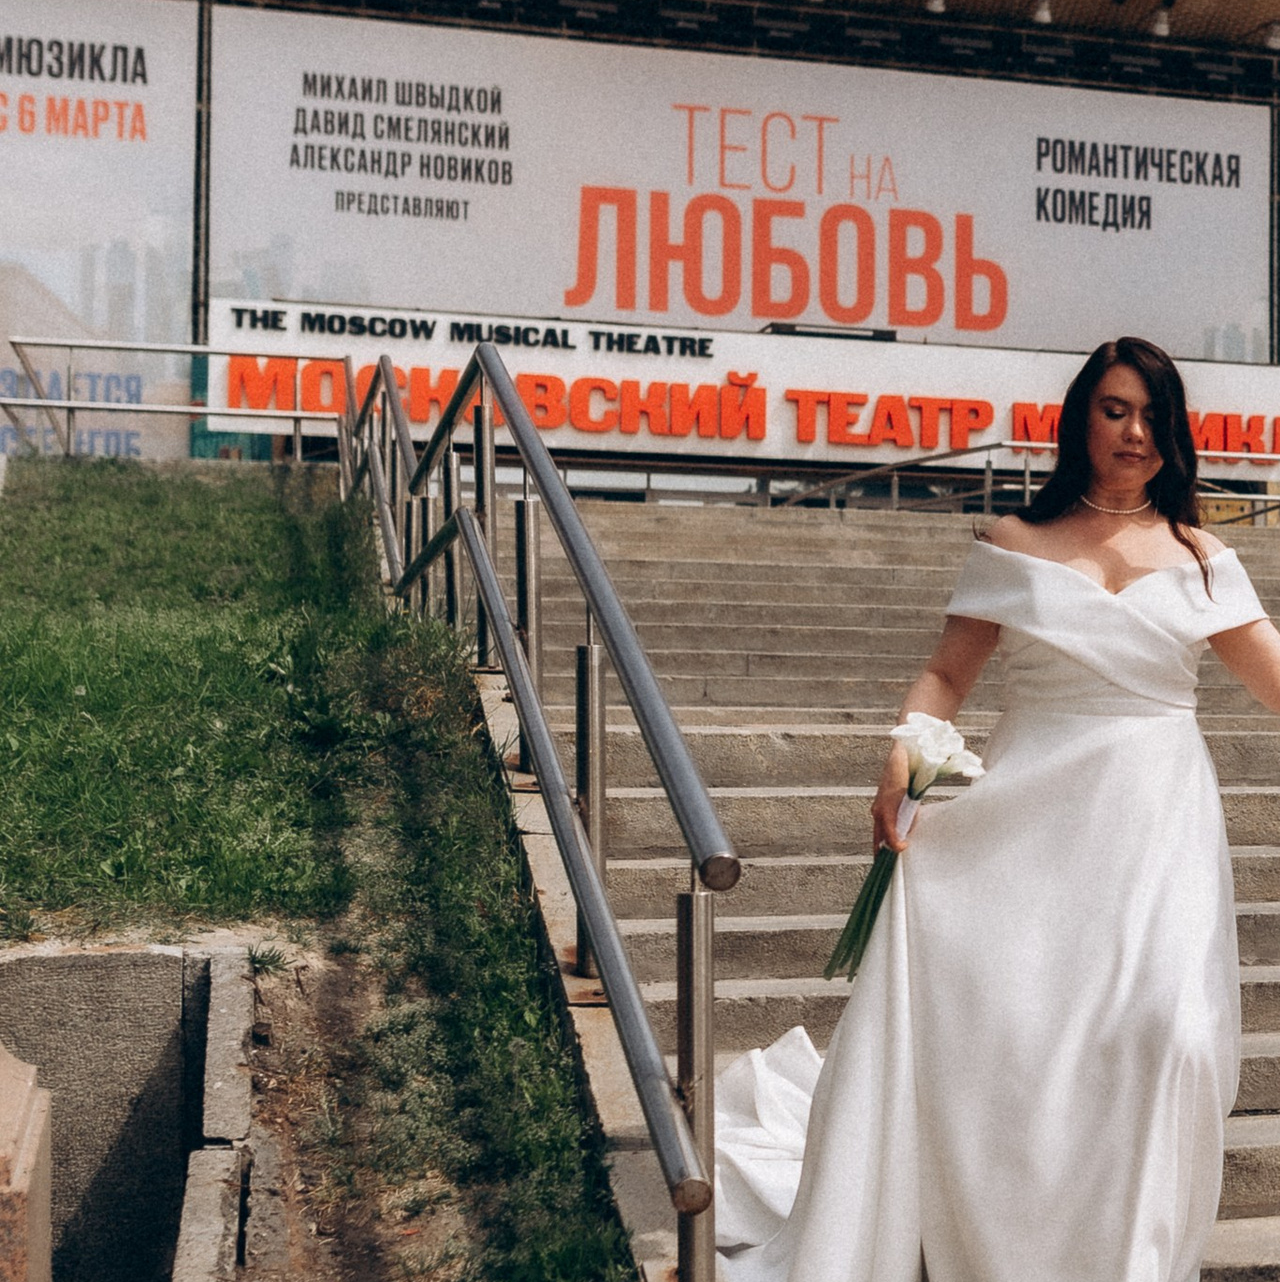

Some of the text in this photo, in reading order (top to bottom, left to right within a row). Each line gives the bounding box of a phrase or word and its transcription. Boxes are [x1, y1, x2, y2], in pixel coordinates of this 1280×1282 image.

[18, 93, 36, 135] 6
[46, 95, 148, 143] МАРТА
[302, 71, 503, 116] МИХАИЛ ШВЫДКОЙ
[293, 106, 510, 150] ДАВИД СМЕЛЯНСКИЙ
[671, 102, 899, 202] ТЕСТ НА
[289, 143, 514, 186] АЛЕКСАНДР НОВИКОВ
[1036, 136, 1241, 189] РОМАНТИЧЕСКАЯ
[334, 190, 470, 221] ПРЕДСТАВЛЯЮТ
[1036, 186, 1152, 233] КОМЕДИЯ
[564, 184, 1009, 333] ЛЮБОВЬ
[230, 307, 715, 359] THE MOSCOW MUSICAL THEATRE
[785, 388, 995, 450] ТЕАТР
